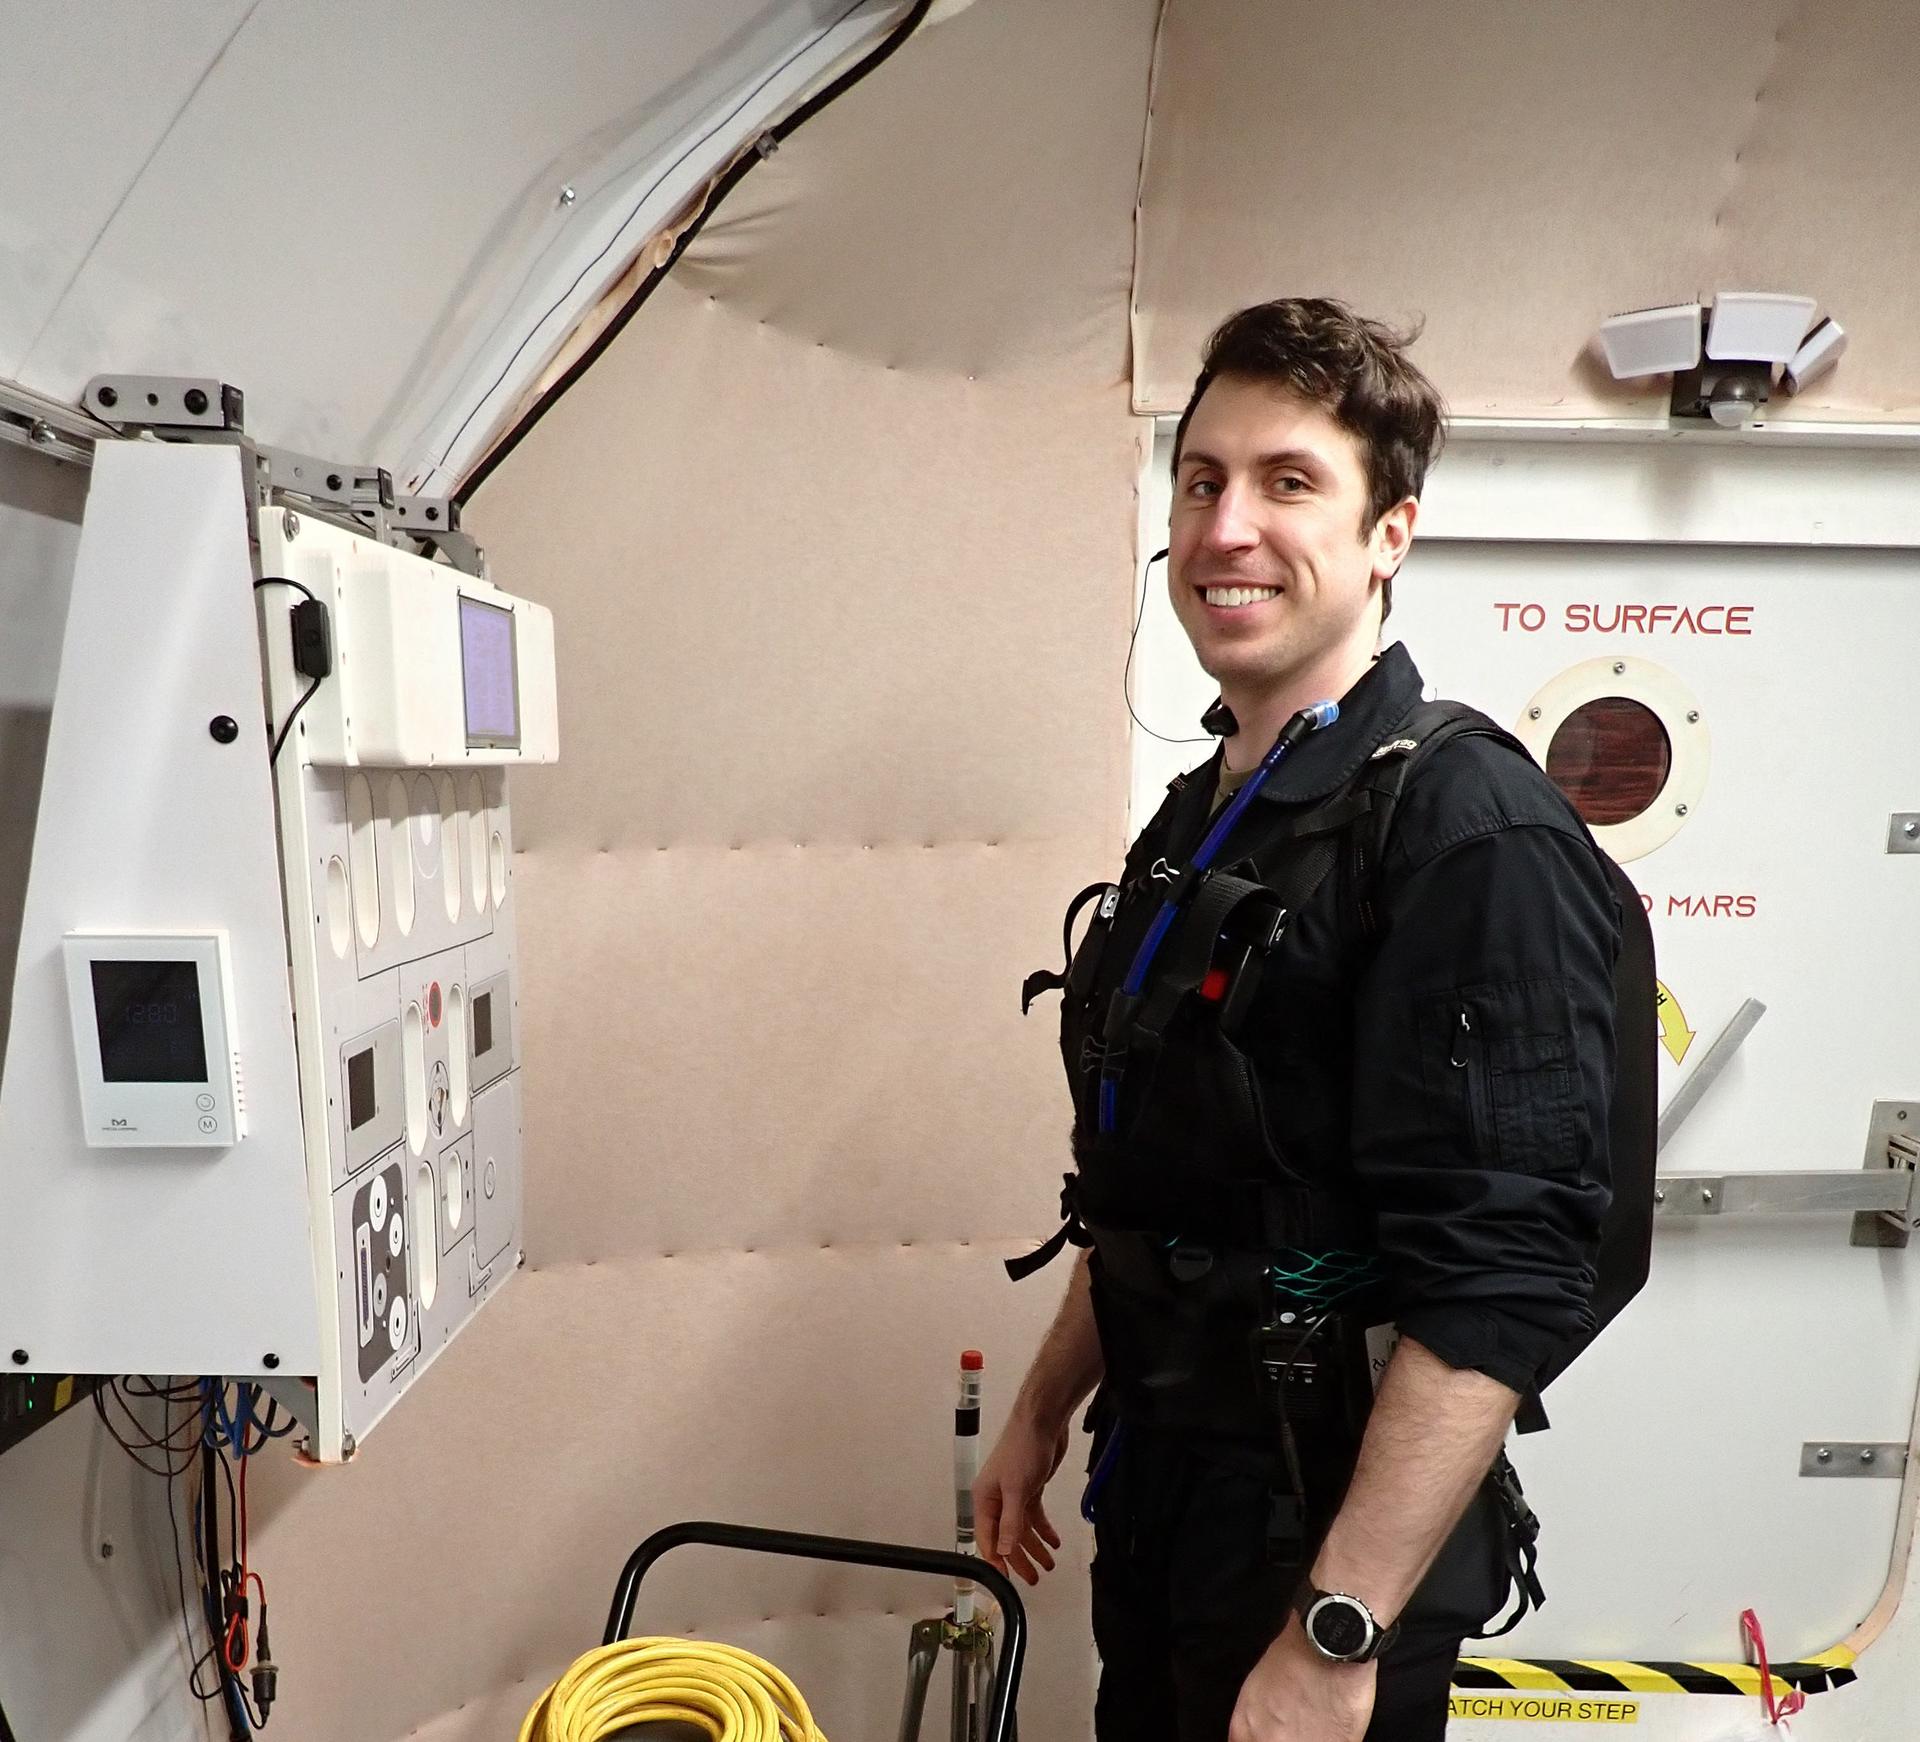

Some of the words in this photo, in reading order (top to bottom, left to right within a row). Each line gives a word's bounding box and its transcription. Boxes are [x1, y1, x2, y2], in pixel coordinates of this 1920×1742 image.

[1493, 603, 1546, 632] TO
[1564, 604, 1754, 635] SURFACE
[1667, 895, 1757, 918] MARS
[1448, 1699, 1504, 1717] ATCH
[1510, 1700, 1572, 1718] YOUR
[1578, 1702, 1636, 1720] STEP
